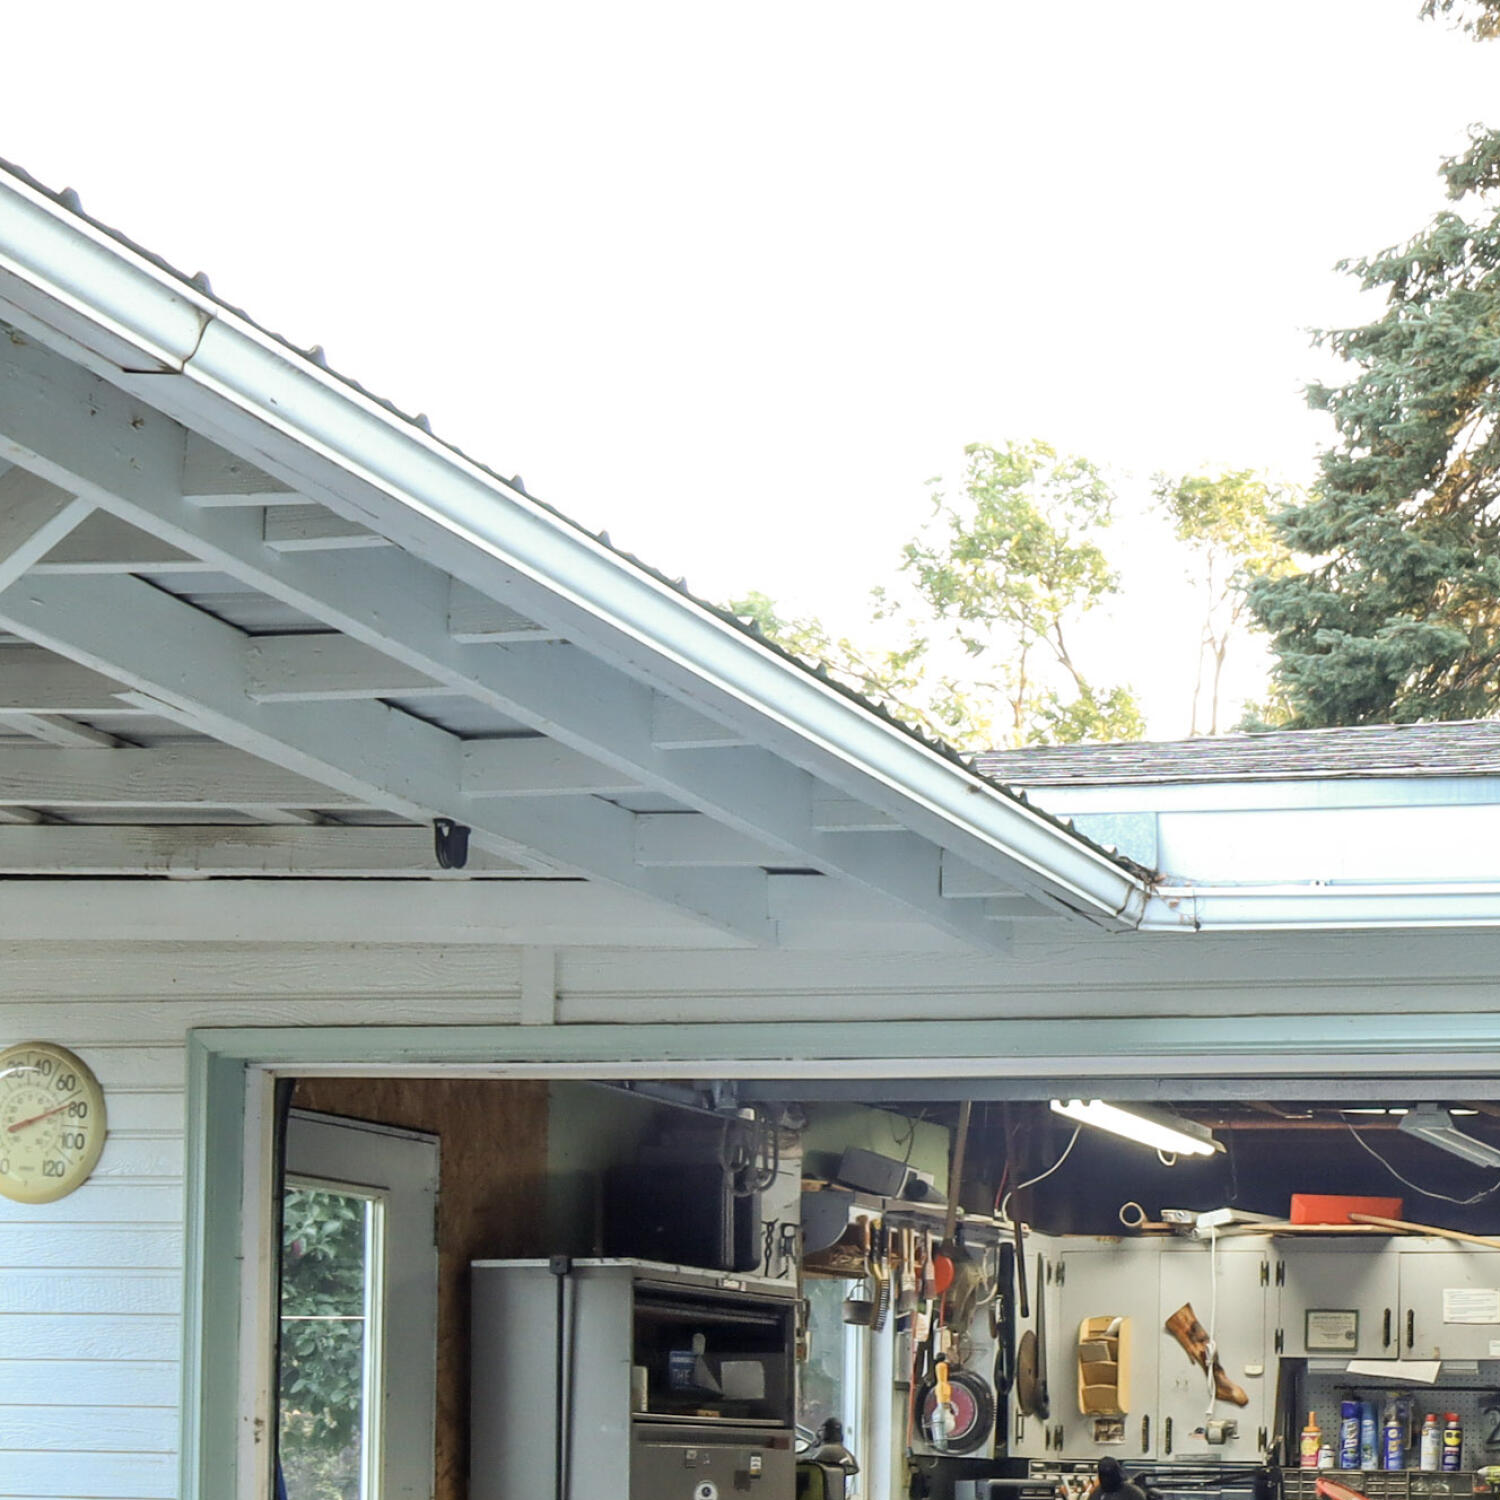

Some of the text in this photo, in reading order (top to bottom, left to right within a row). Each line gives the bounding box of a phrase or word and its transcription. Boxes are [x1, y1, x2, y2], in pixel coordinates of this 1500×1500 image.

[32, 1059, 52, 1076] 40
[56, 1074, 76, 1091] 60
[68, 1101, 88, 1118] 80
[62, 1133, 85, 1150] 100
[42, 1159, 66, 1177] 120
